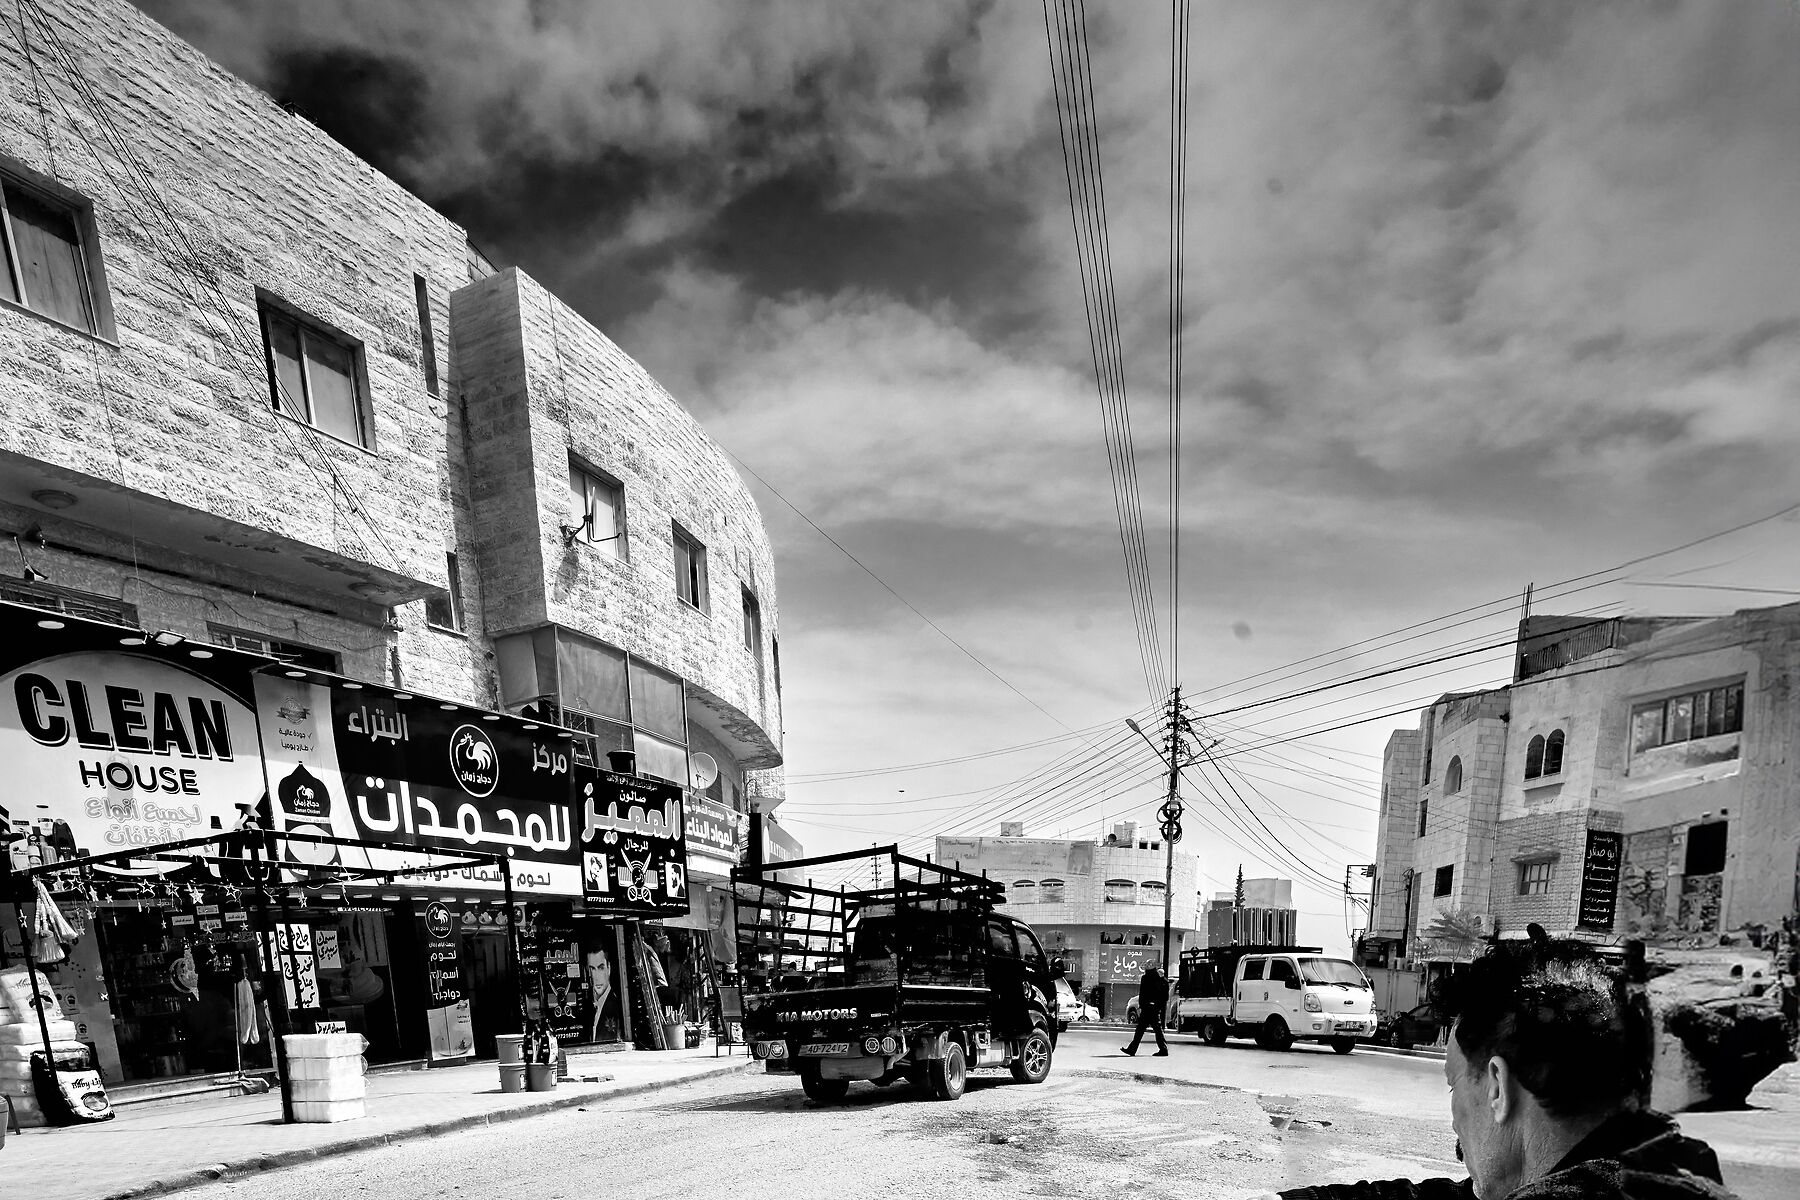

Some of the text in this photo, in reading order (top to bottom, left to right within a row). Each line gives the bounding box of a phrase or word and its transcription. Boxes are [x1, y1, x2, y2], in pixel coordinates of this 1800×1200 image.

[14, 673, 234, 762] CLEAN
[348, 705, 409, 746] البتراء
[532, 742, 568, 776] مركز
[79, 760, 201, 795] HOUSE
[461, 771, 492, 784] دجاج زمان
[619, 789, 647, 804] صالون
[141, 802, 202, 828] لجميع
[356, 776, 572, 856] للمجمدات
[581, 783, 681, 845] المميز
[624, 838, 649, 852] للرجال
[686, 816, 733, 849] لمواد البناء
[516, 872, 551, 888] لحوم
[430, 950, 457, 961] لحوم
[801, 1008, 858, 1021] MOTORS
